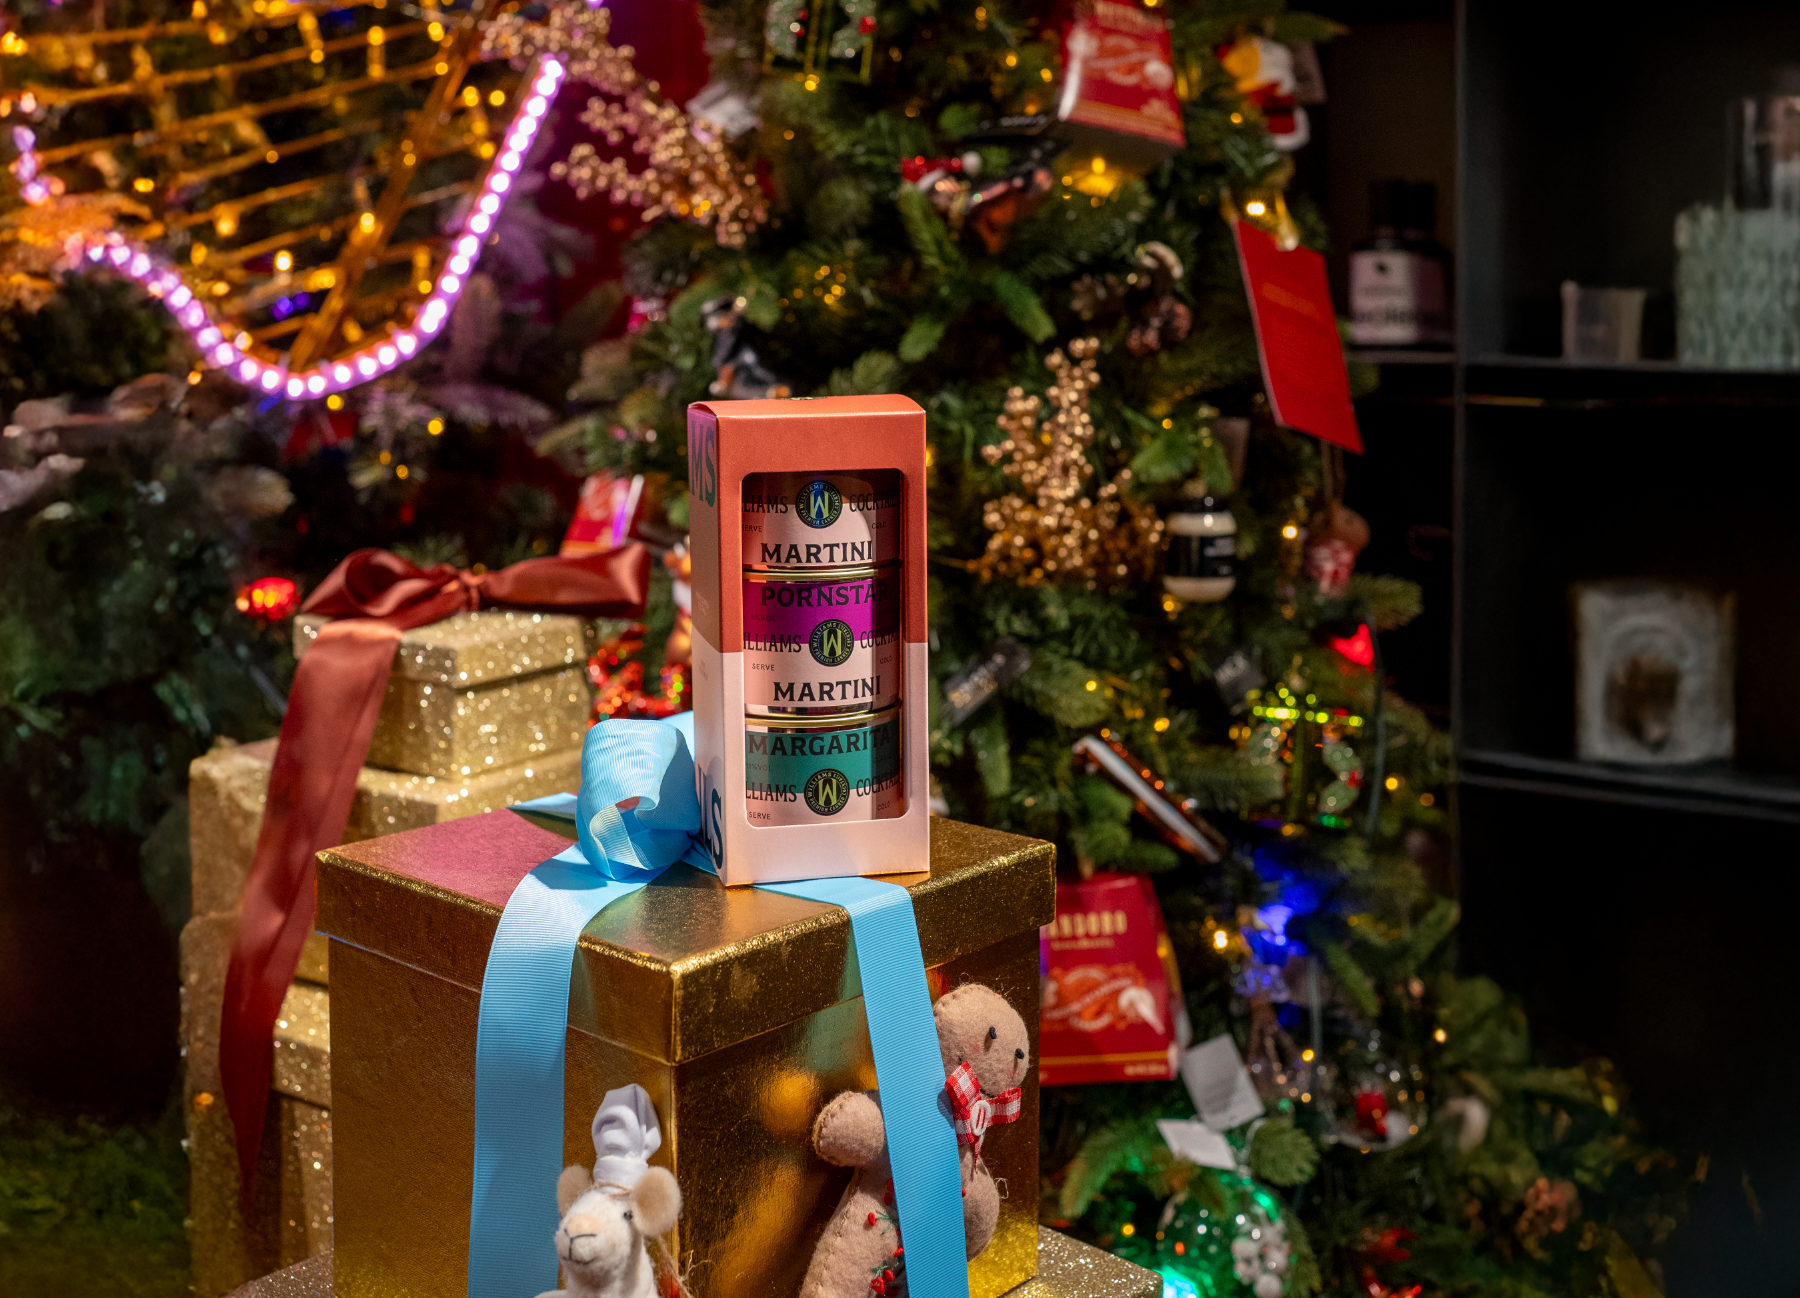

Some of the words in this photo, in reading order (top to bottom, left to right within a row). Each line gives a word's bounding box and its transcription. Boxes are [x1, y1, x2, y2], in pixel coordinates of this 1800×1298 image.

[742, 494, 788, 514] LIAMS
[760, 540, 873, 564] MARTINI
[760, 581, 888, 608] PORNSTAR
[752, 662, 775, 672] SERVE
[773, 675, 881, 702] MARTINI
[748, 725, 891, 757] MARGARITA
[748, 811, 771, 821] SERVE
